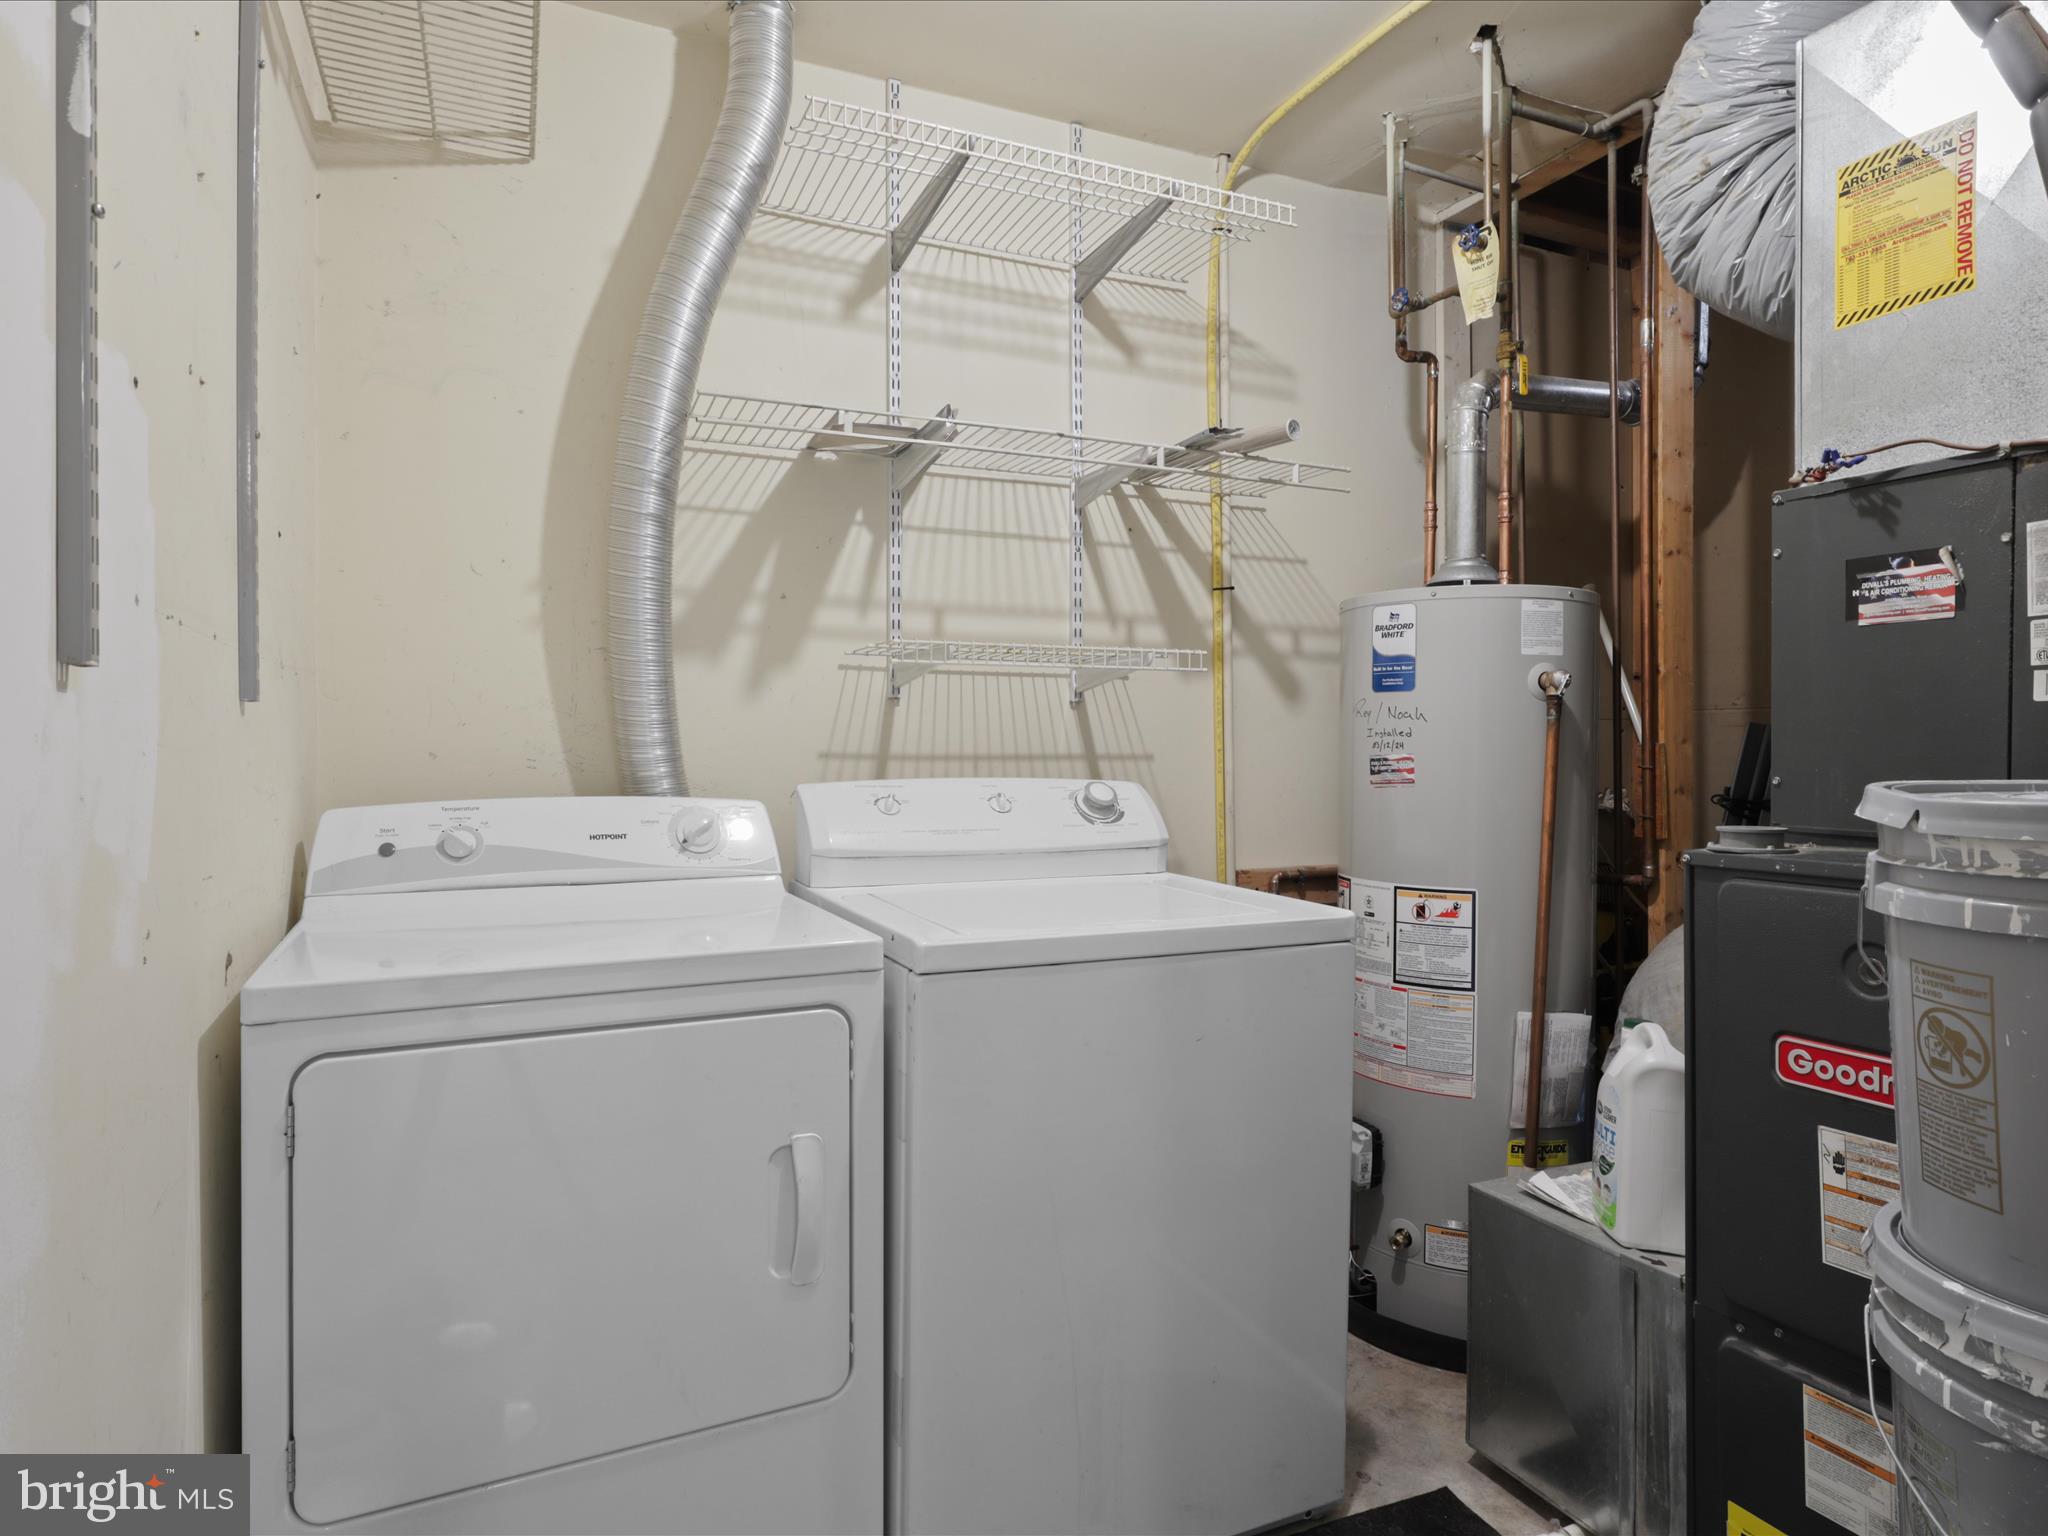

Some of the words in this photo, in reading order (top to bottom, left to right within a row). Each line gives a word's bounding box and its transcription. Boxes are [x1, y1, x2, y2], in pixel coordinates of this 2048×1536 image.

[1957, 127, 1975, 157] DO
[1840, 162, 1893, 192] ARCTIC
[1921, 137, 1953, 158] SUN
[1957, 158, 1974, 195] NOT
[1956, 197, 1974, 278] REMOVE
[1375, 623, 1414, 632] BRADFORD
[1381, 630, 1404, 639] WHITE
[1388, 705, 1428, 723] Noah
[1366, 727, 1412, 739] Installed
[589, 833, 627, 841] HOTPOINT
